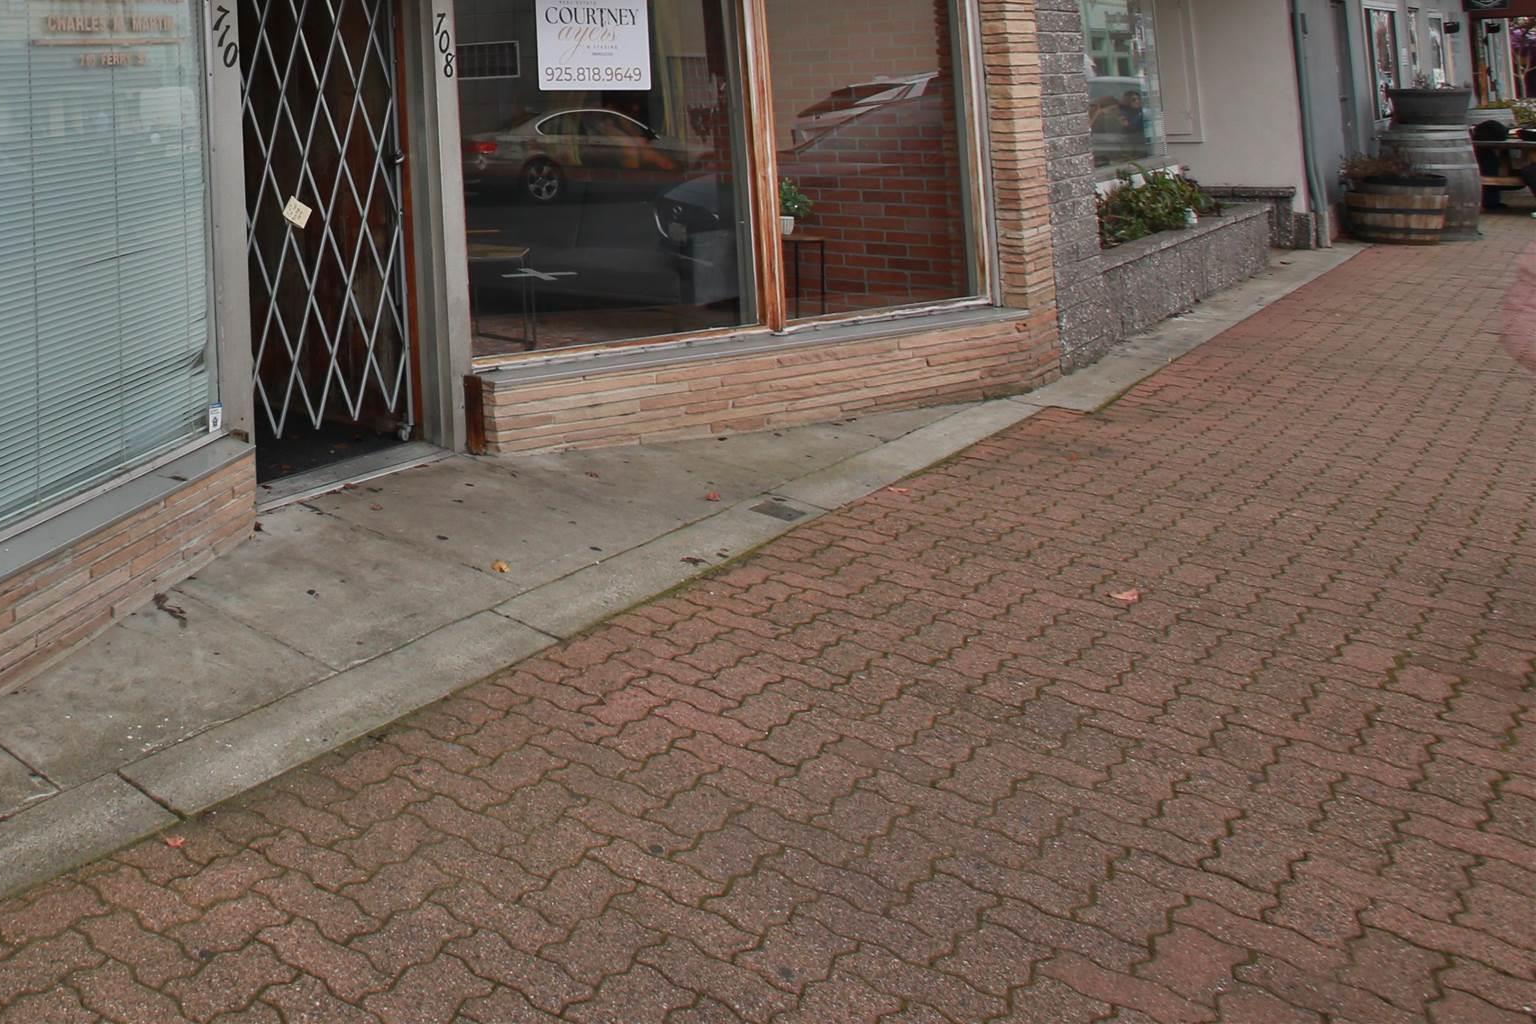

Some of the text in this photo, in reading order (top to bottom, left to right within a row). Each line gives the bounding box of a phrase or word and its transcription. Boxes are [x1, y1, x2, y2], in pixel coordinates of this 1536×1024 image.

[212, 5, 238, 69] 710
[544, 7, 637, 28] COURTNEY
[434, 13, 455, 78] 708
[544, 67, 642, 82] 925.818.9649
